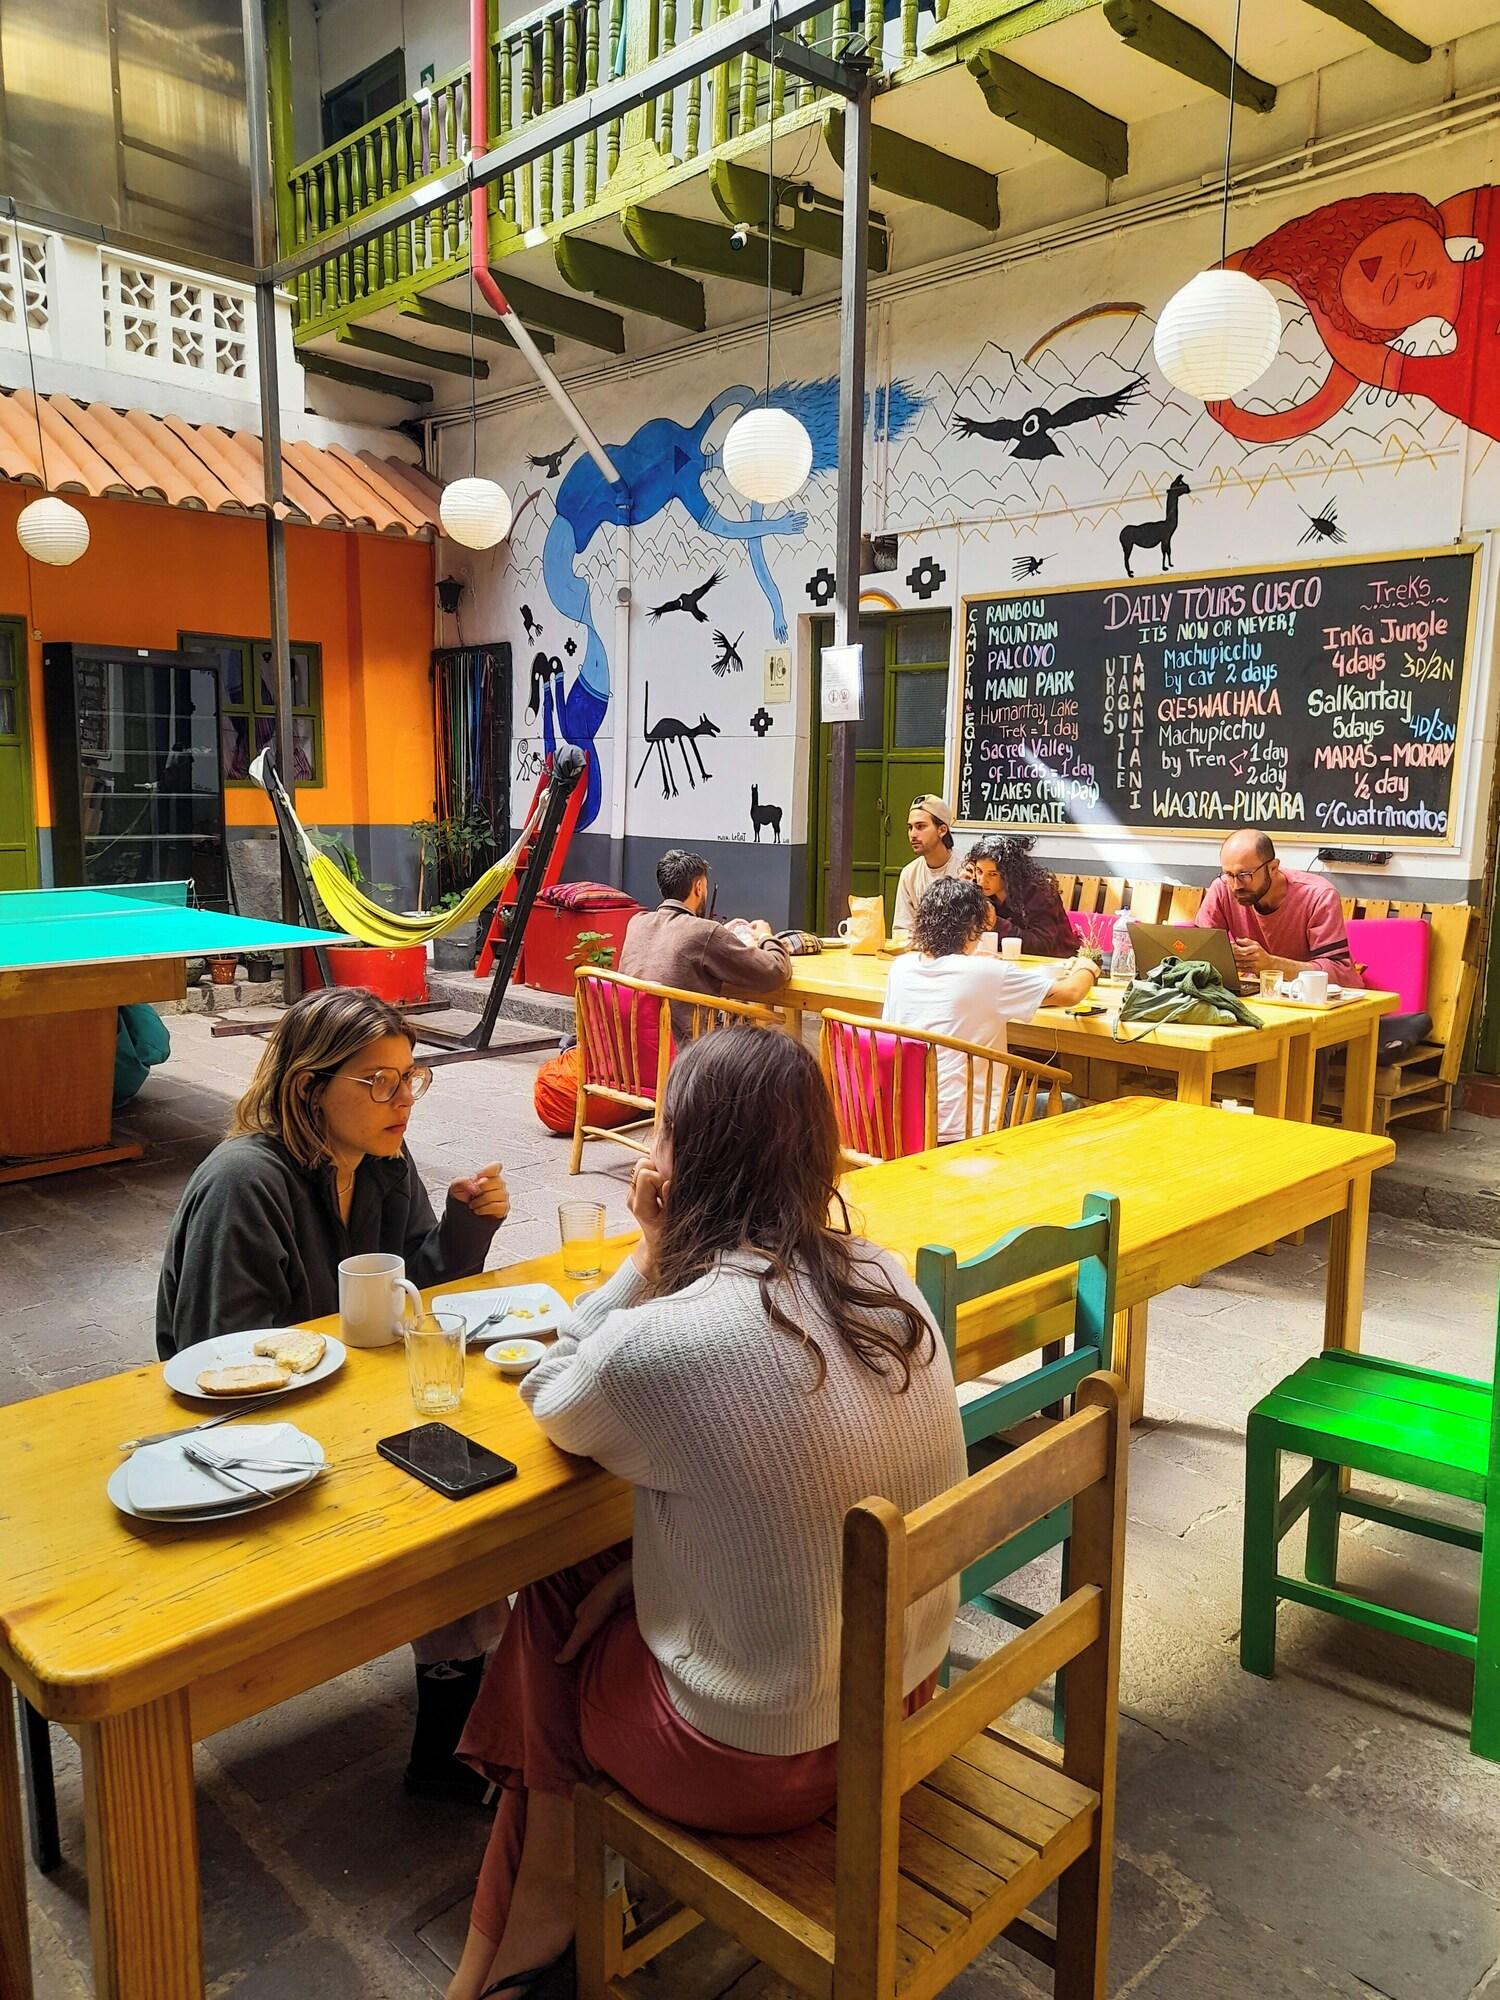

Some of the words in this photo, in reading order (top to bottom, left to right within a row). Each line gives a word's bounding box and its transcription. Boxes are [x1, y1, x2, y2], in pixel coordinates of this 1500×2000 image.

[986, 599, 1045, 625] RAINBOW
[1103, 591, 1173, 630] DAILY
[1177, 584, 1246, 620] TOURS
[1251, 576, 1322, 615] CUSCO
[988, 620, 1058, 646] MOUNTAIN
[1176, 620, 1209, 642] NOW
[1213, 618, 1232, 637] OR
[1237, 611, 1296, 637] NEVER!
[1380, 609, 1448, 651] Jungle
[988, 643, 1056, 672] PALCOYO
[1163, 636, 1262, 671] Machupicchu
[1400, 648, 1455, 683] 3D/2N
[985, 676, 1028, 701] MANU
[1035, 670, 1075, 696] PARK
[1165, 671, 1182, 694] by
[1188, 669, 1215, 687] car
[1225, 665, 1237, 684] 2
[1241, 660, 1278, 693] days
[981, 698, 1046, 725] Humantay
[1103, 657, 1117, 735] UROS
[1116, 655, 1132, 789] TAQUILE
[1129, 652, 1145, 810] AMANTANI
[1159, 718, 1265, 752] Machupicchu
[1409, 708, 1456, 743] 4D/3N
[980, 737, 1026, 761] Sacred
[1031, 738, 1074, 761] Valley
[1162, 750, 1182, 778] by
[1186, 748, 1226, 768] Tren
[988, 765, 1004, 783] of
[1007, 759, 1047, 780] Incas
[1374, 768, 1409, 801] day
[984, 801, 1066, 824] AUSANGATE
